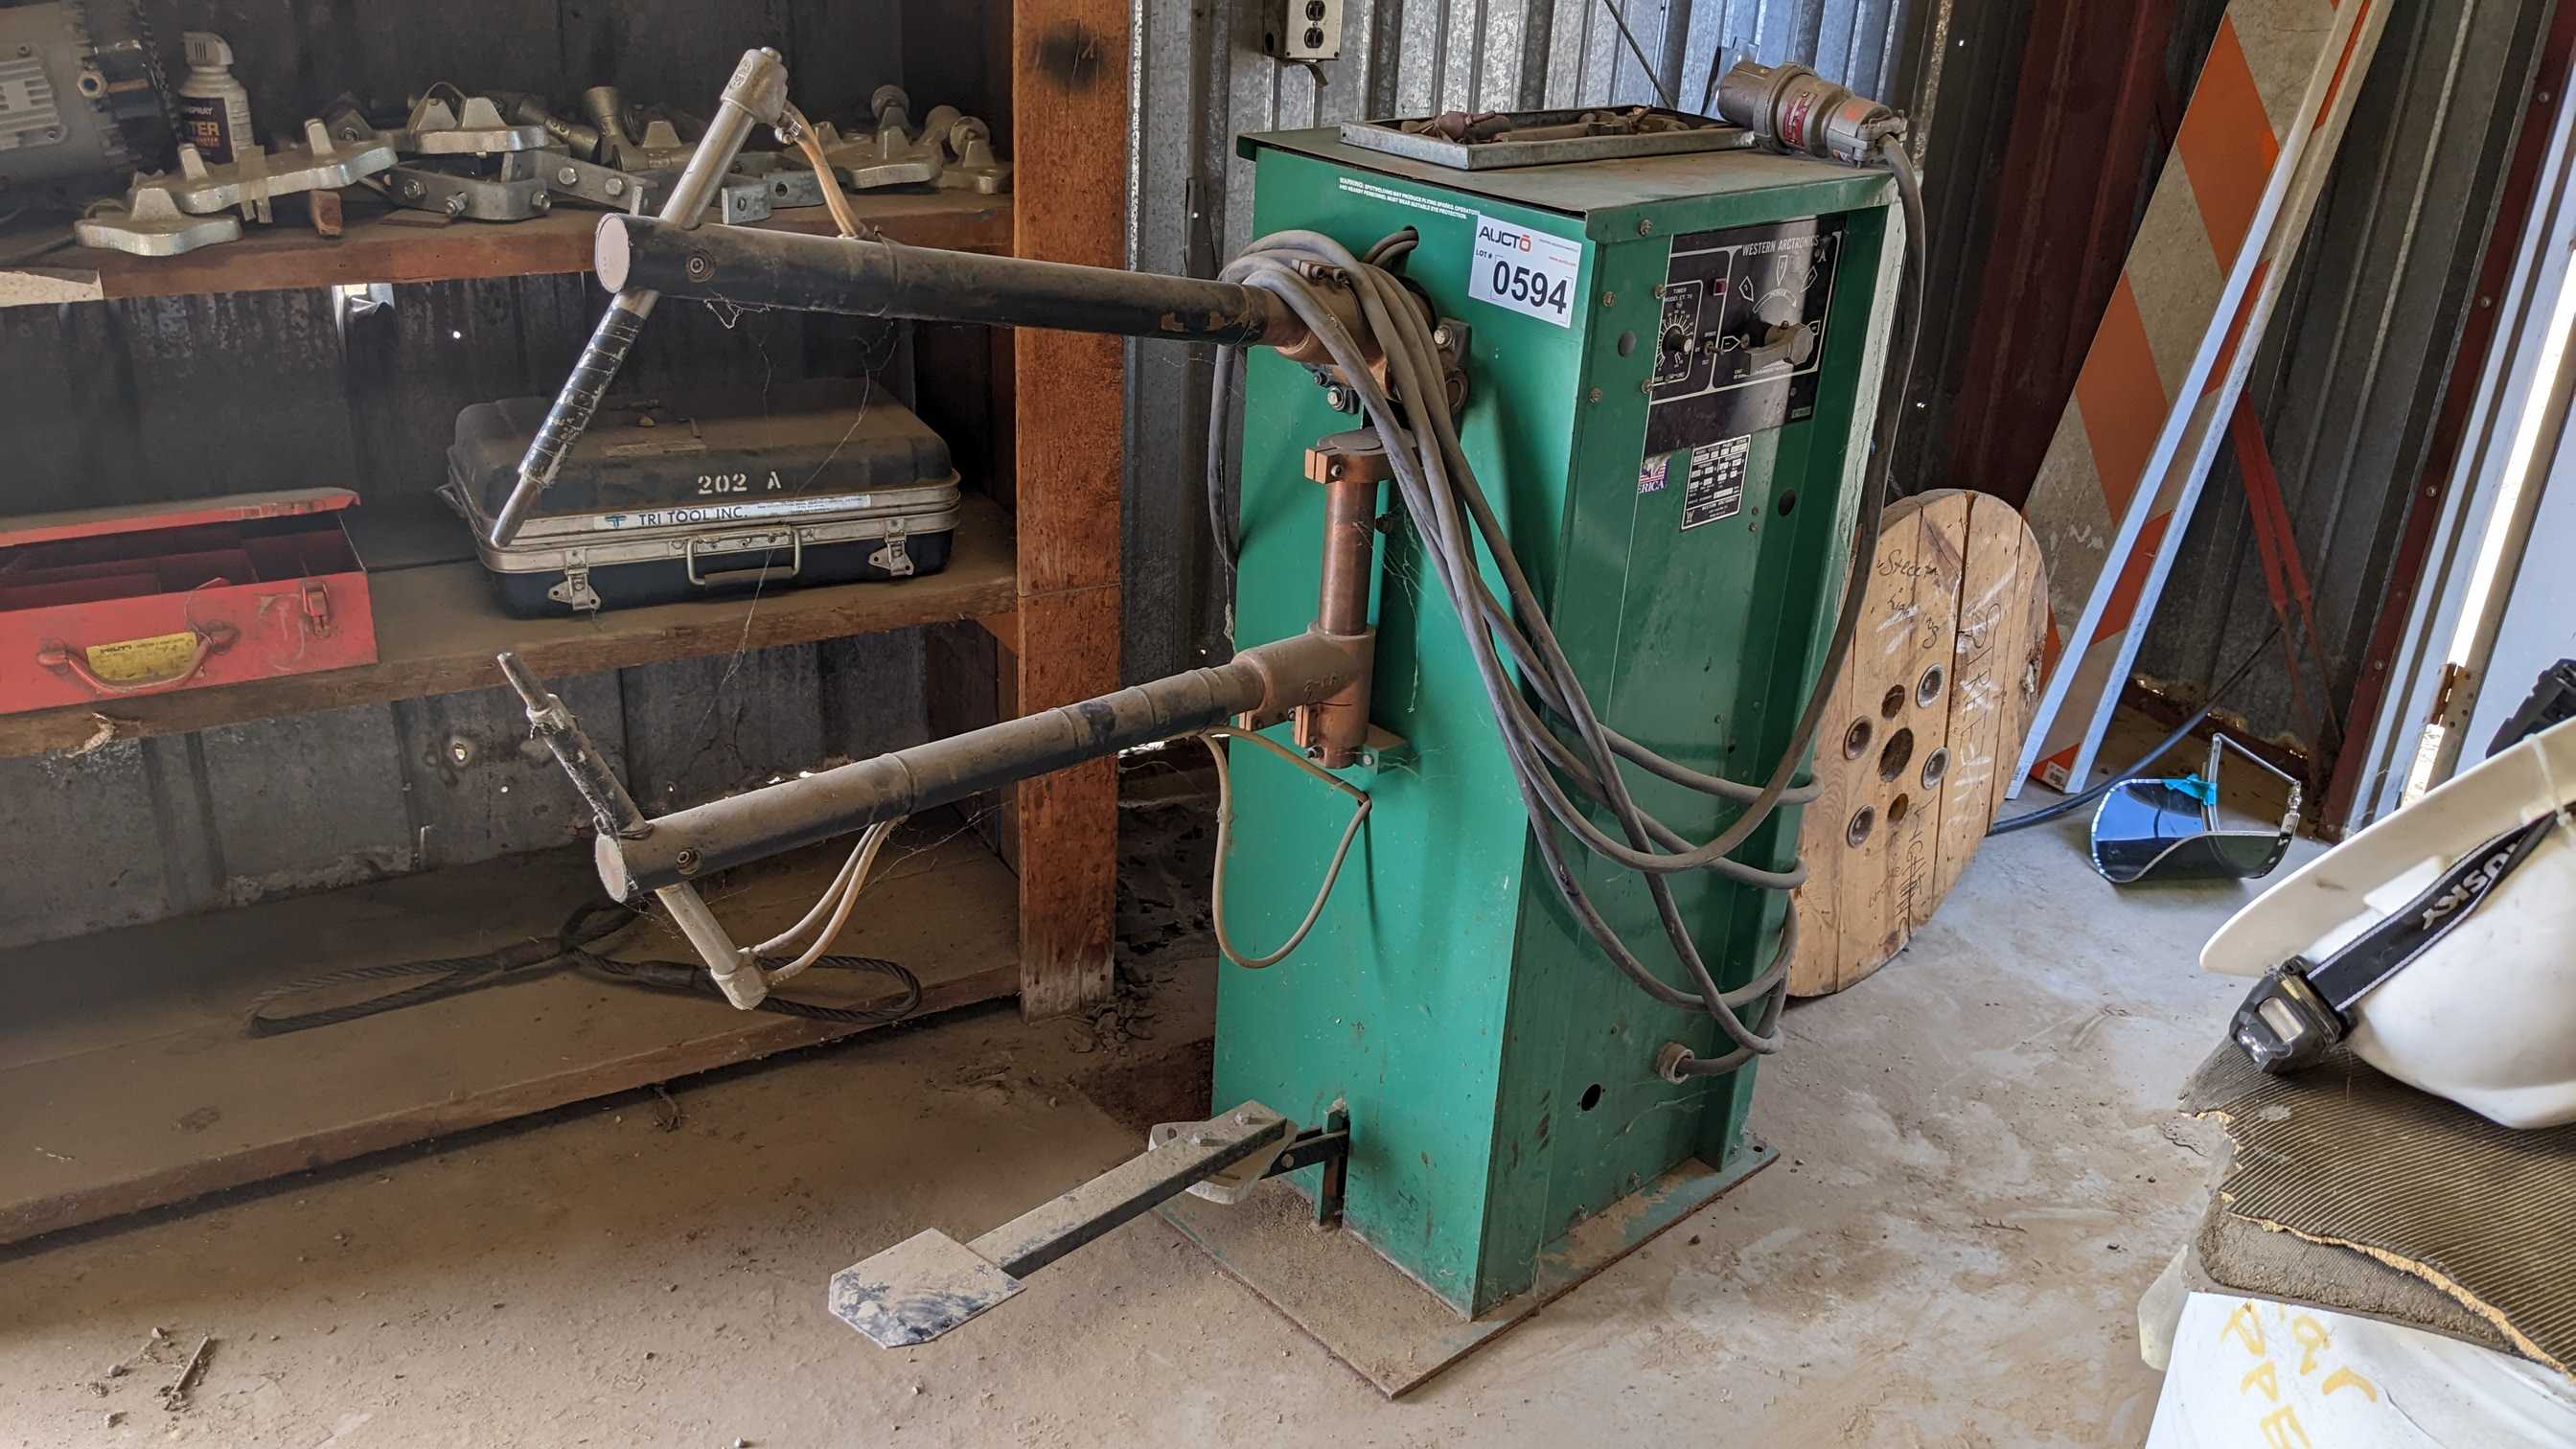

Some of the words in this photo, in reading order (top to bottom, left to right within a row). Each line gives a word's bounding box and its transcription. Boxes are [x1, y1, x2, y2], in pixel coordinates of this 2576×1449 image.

[1476, 249, 1487, 258] LOT
[1742, 241, 1776, 256] WESTERN
[1492, 260, 1567, 315] 0594
[698, 473, 748, 494] 202
[767, 471, 782, 490] A
[638, 513, 662, 526] TRI
[667, 510, 710, 523] TOOL
[716, 506, 748, 519] INC.
[2423, 838, 2520, 931] USKY
